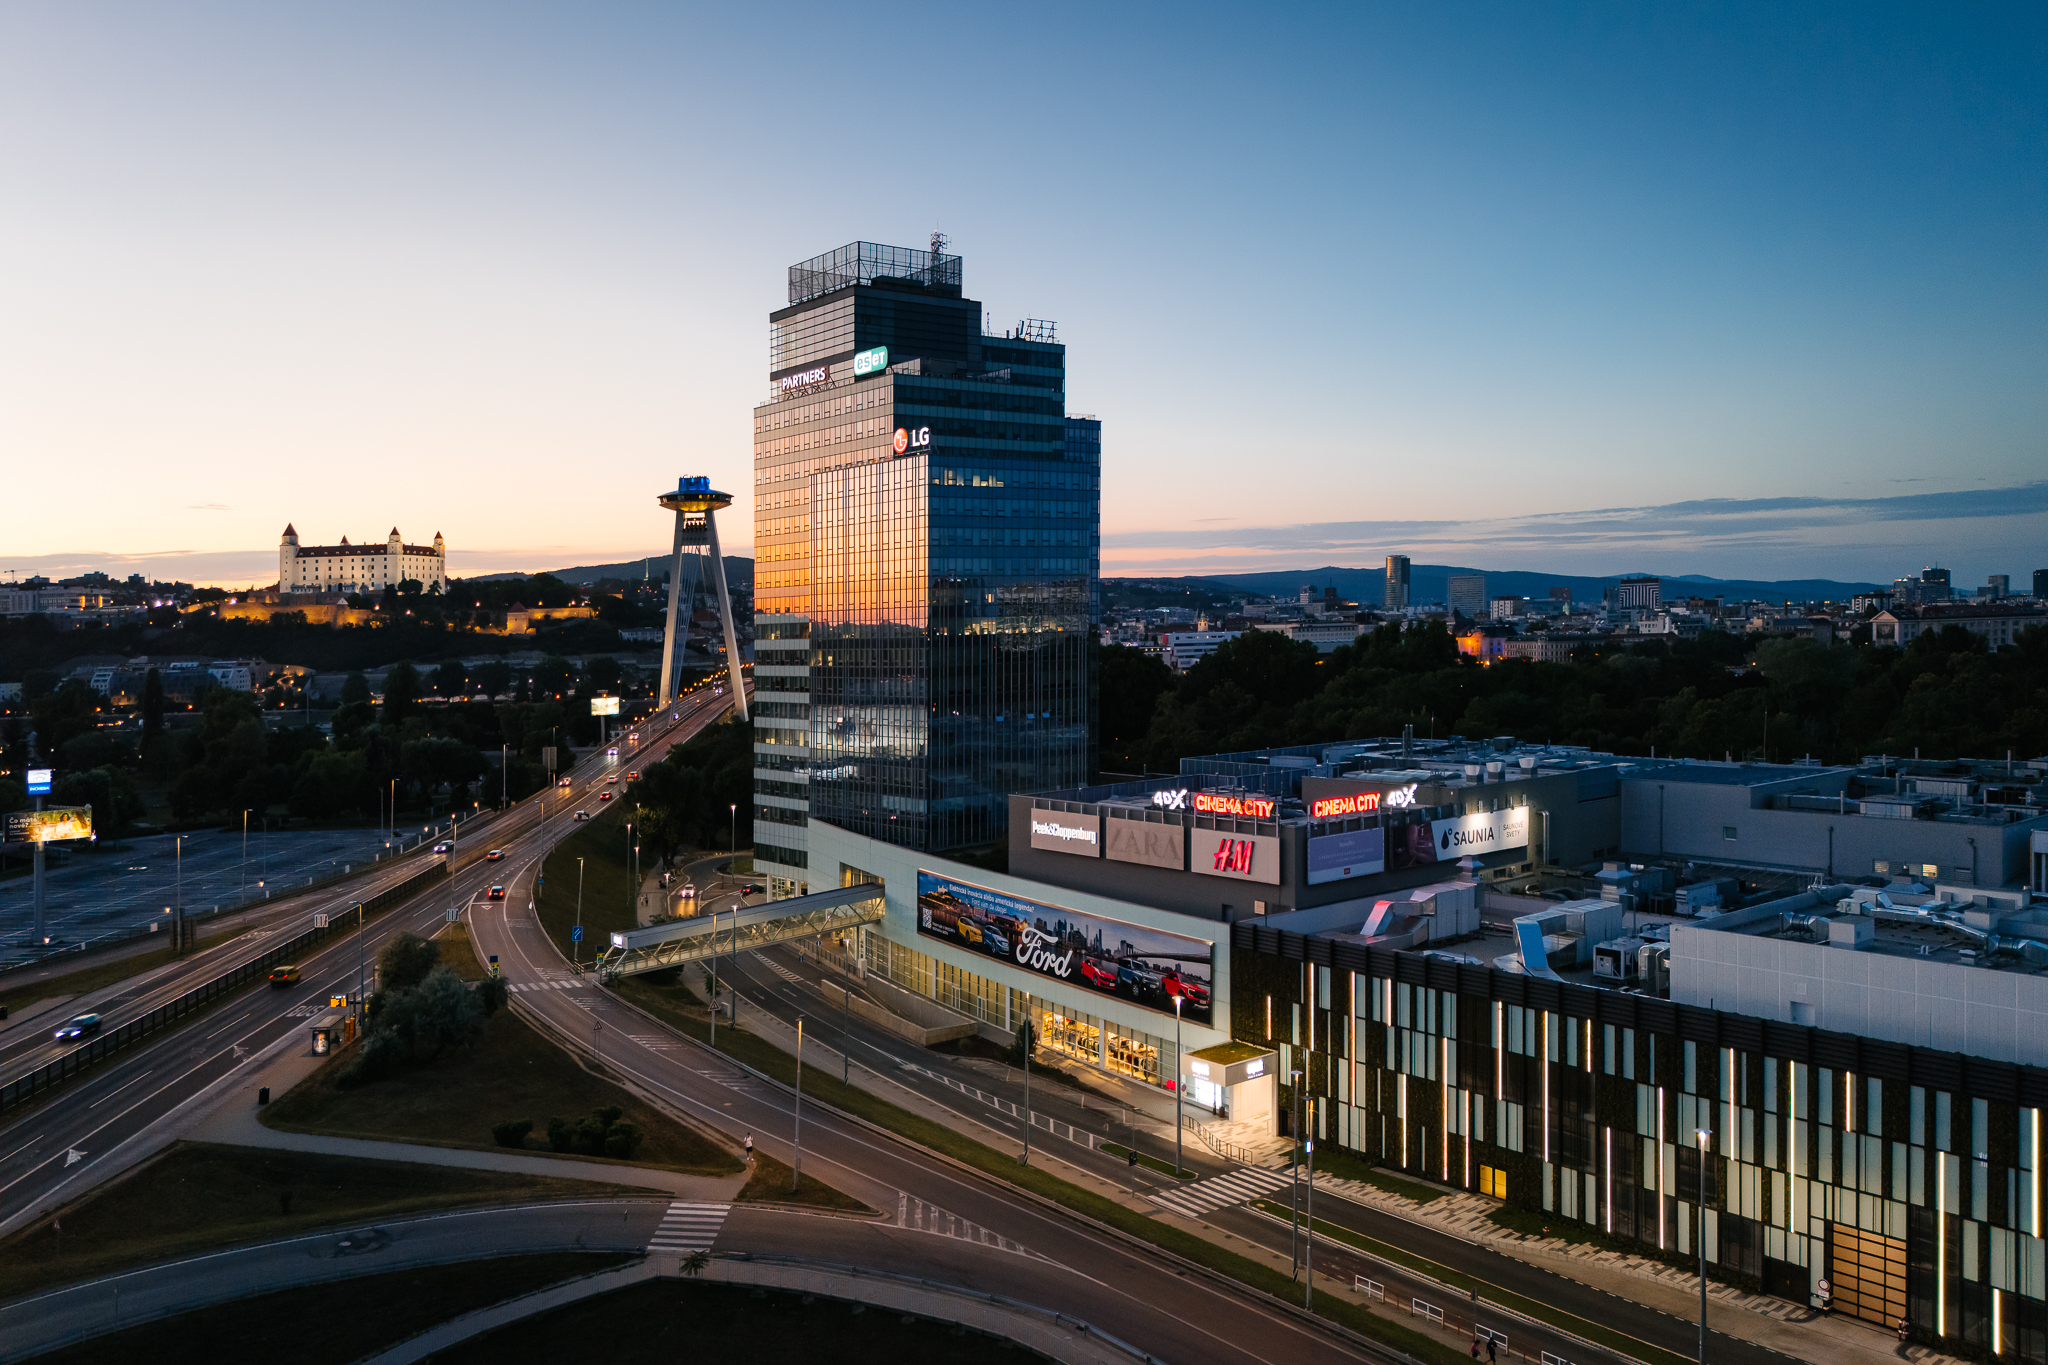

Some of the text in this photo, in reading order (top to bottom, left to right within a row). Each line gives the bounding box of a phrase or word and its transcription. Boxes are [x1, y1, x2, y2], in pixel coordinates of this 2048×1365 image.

[782, 367, 826, 390] PARTNERS
[912, 427, 930, 447] LG
[1153, 789, 1187, 810] 4DX
[1195, 795, 1274, 818] CINEMA CITY
[1314, 793, 1381, 817] CINEMA CITY
[1387, 783, 1418, 808] 4DX
[1108, 829, 1182, 861] ZARA
[1453, 826, 1495, 846] SAUNIA
[1506, 830, 1521, 838] SVETY
[1016, 927, 1073, 978] Ford
[286, 1005, 325, 1017] BUS
